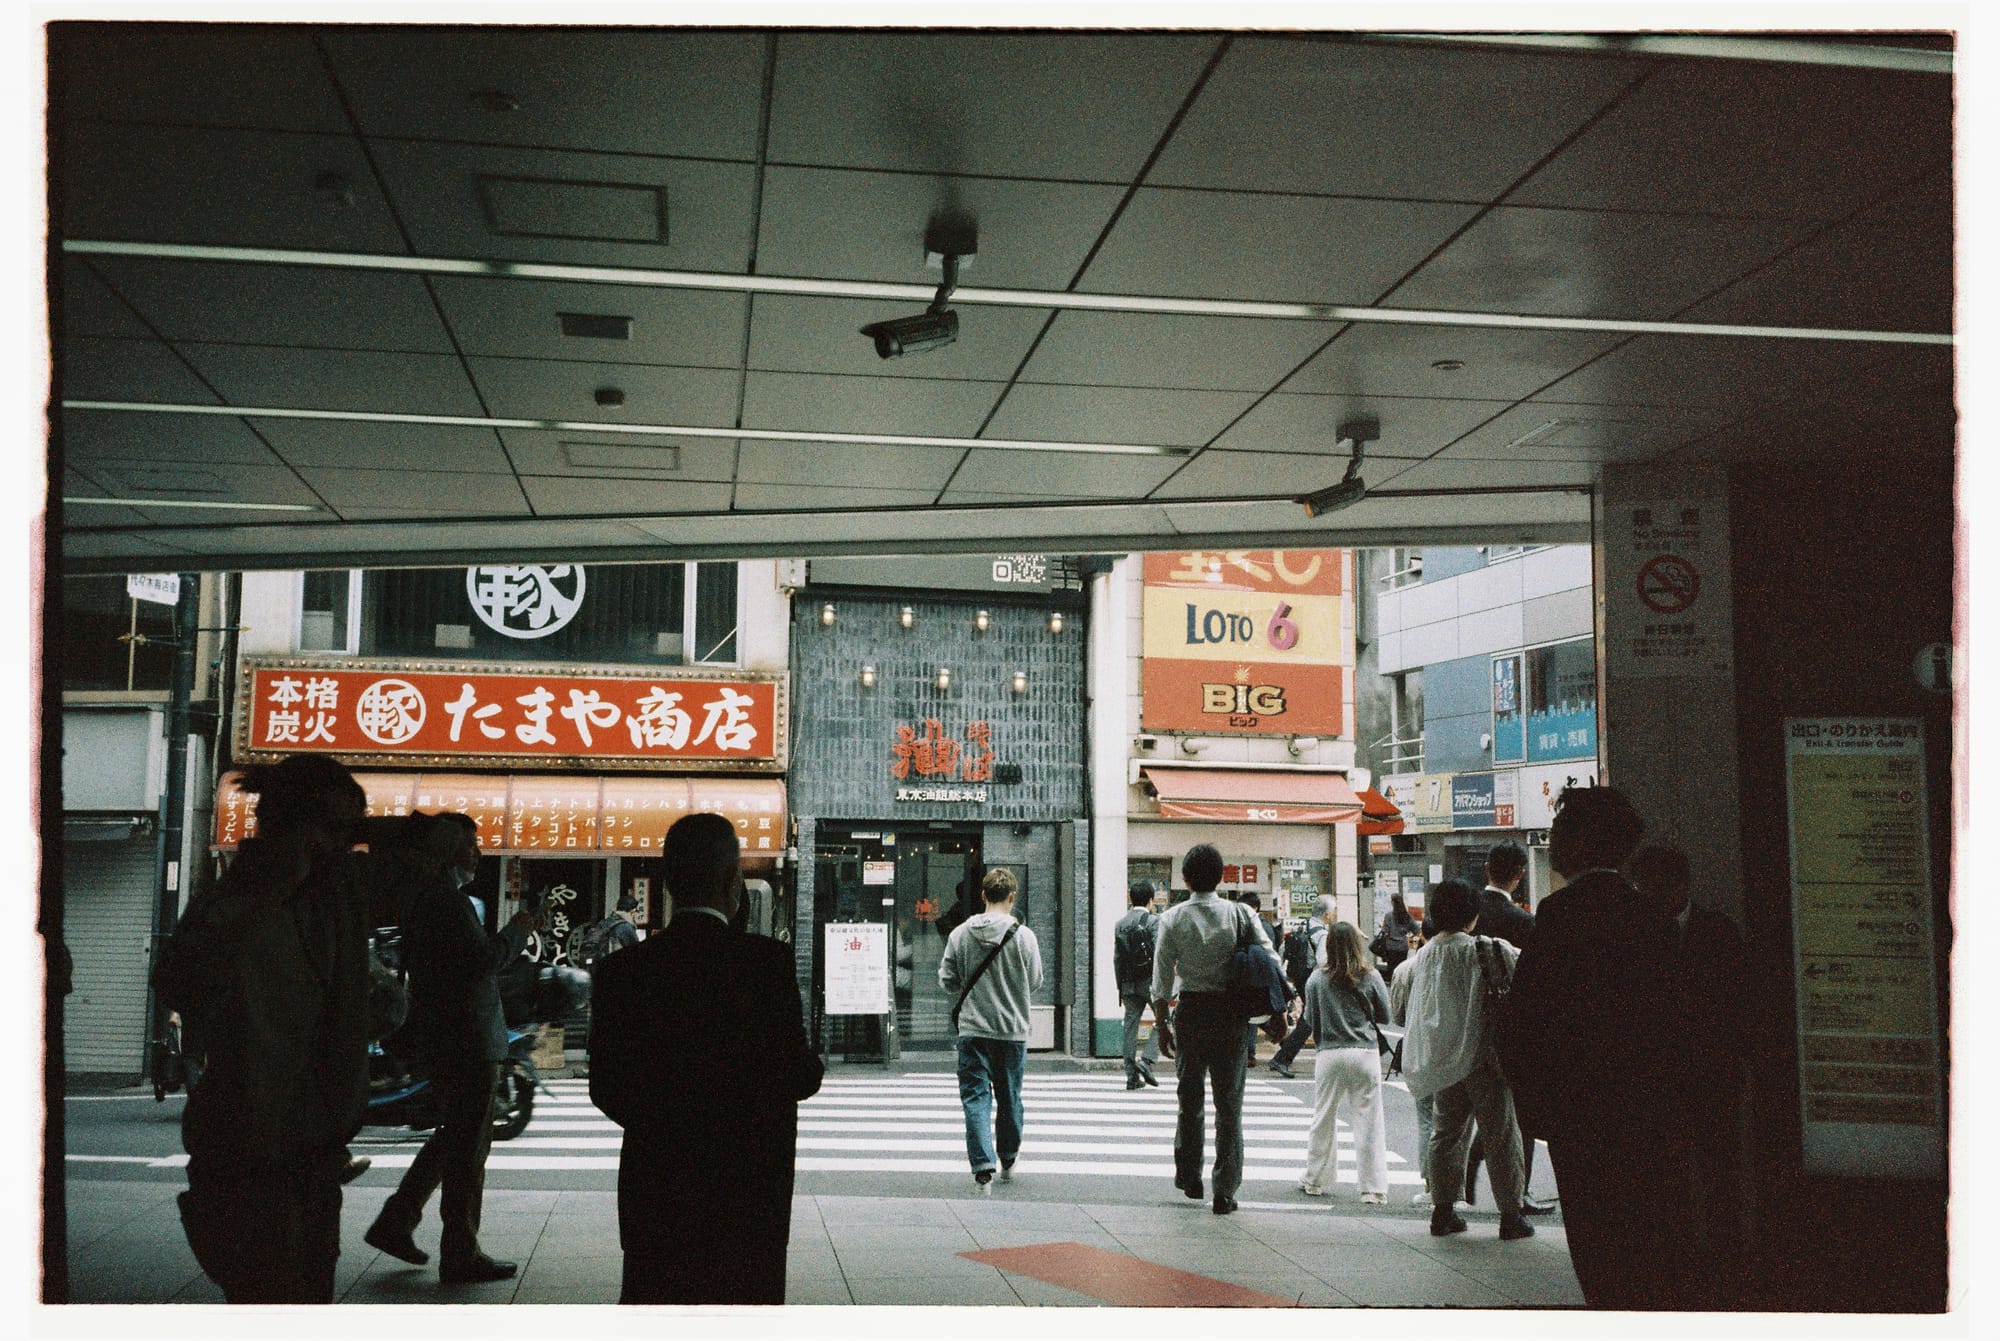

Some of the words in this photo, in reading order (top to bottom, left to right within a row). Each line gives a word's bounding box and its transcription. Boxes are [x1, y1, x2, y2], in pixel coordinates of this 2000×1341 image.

[1186, 602, 1254, 645] LOTO
[1266, 600, 1300, 650] 6
[268, 676, 339, 708] 本格
[1202, 682, 1287, 715] BIG
[265, 709, 337, 743] 炭火
[444, 683, 758, 751] たまや商店
[565, 797, 579, 847] トントロ
[584, 797, 597, 848] レバー
[605, 799, 617, 848] ハラミ
[622, 798, 635, 848] カシラ
[1291, 892, 1318, 903] BIG
